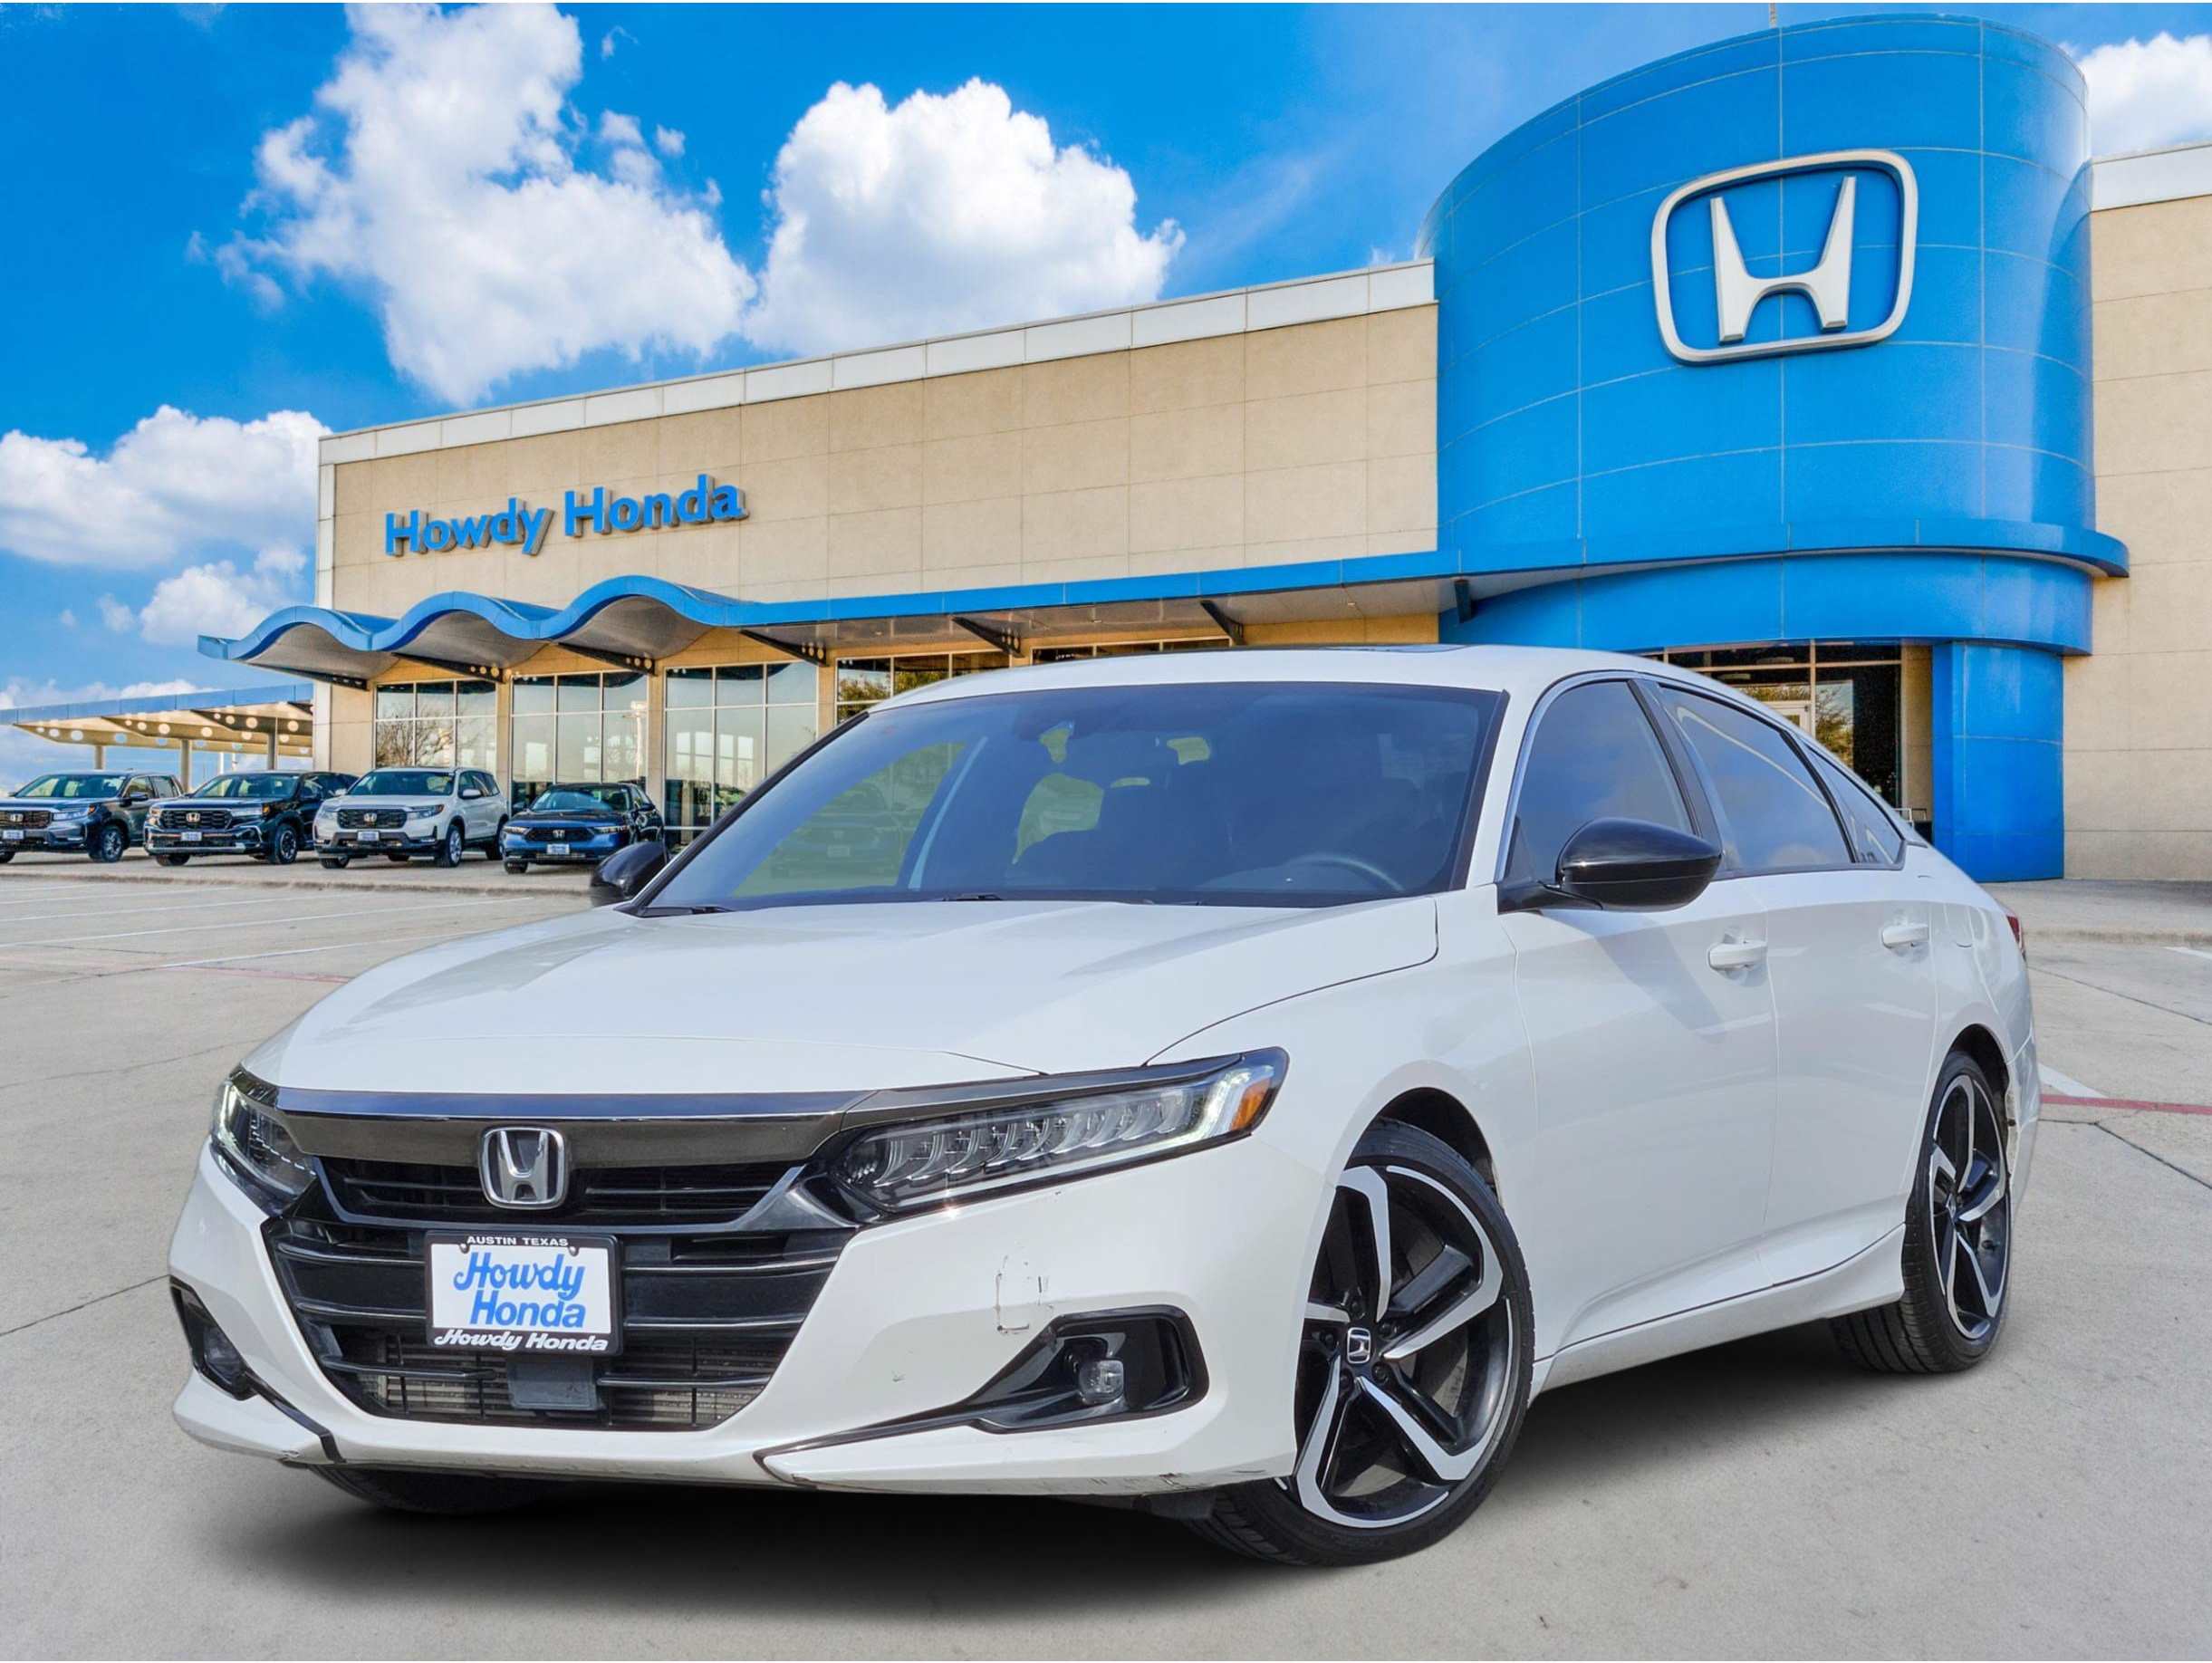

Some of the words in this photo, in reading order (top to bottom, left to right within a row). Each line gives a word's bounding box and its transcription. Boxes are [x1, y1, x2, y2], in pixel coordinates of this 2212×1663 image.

[385, 497, 554, 556] Howdy
[563, 474, 749, 537] Honda
[466, 1235, 516, 1245] AUSTIN
[522, 1237, 569, 1246] TEXAS
[453, 1252, 585, 1301] Howdy
[469, 1289, 586, 1328] Honda
[434, 1329, 523, 1351] Howdy
[525, 1332, 609, 1351] Honda
